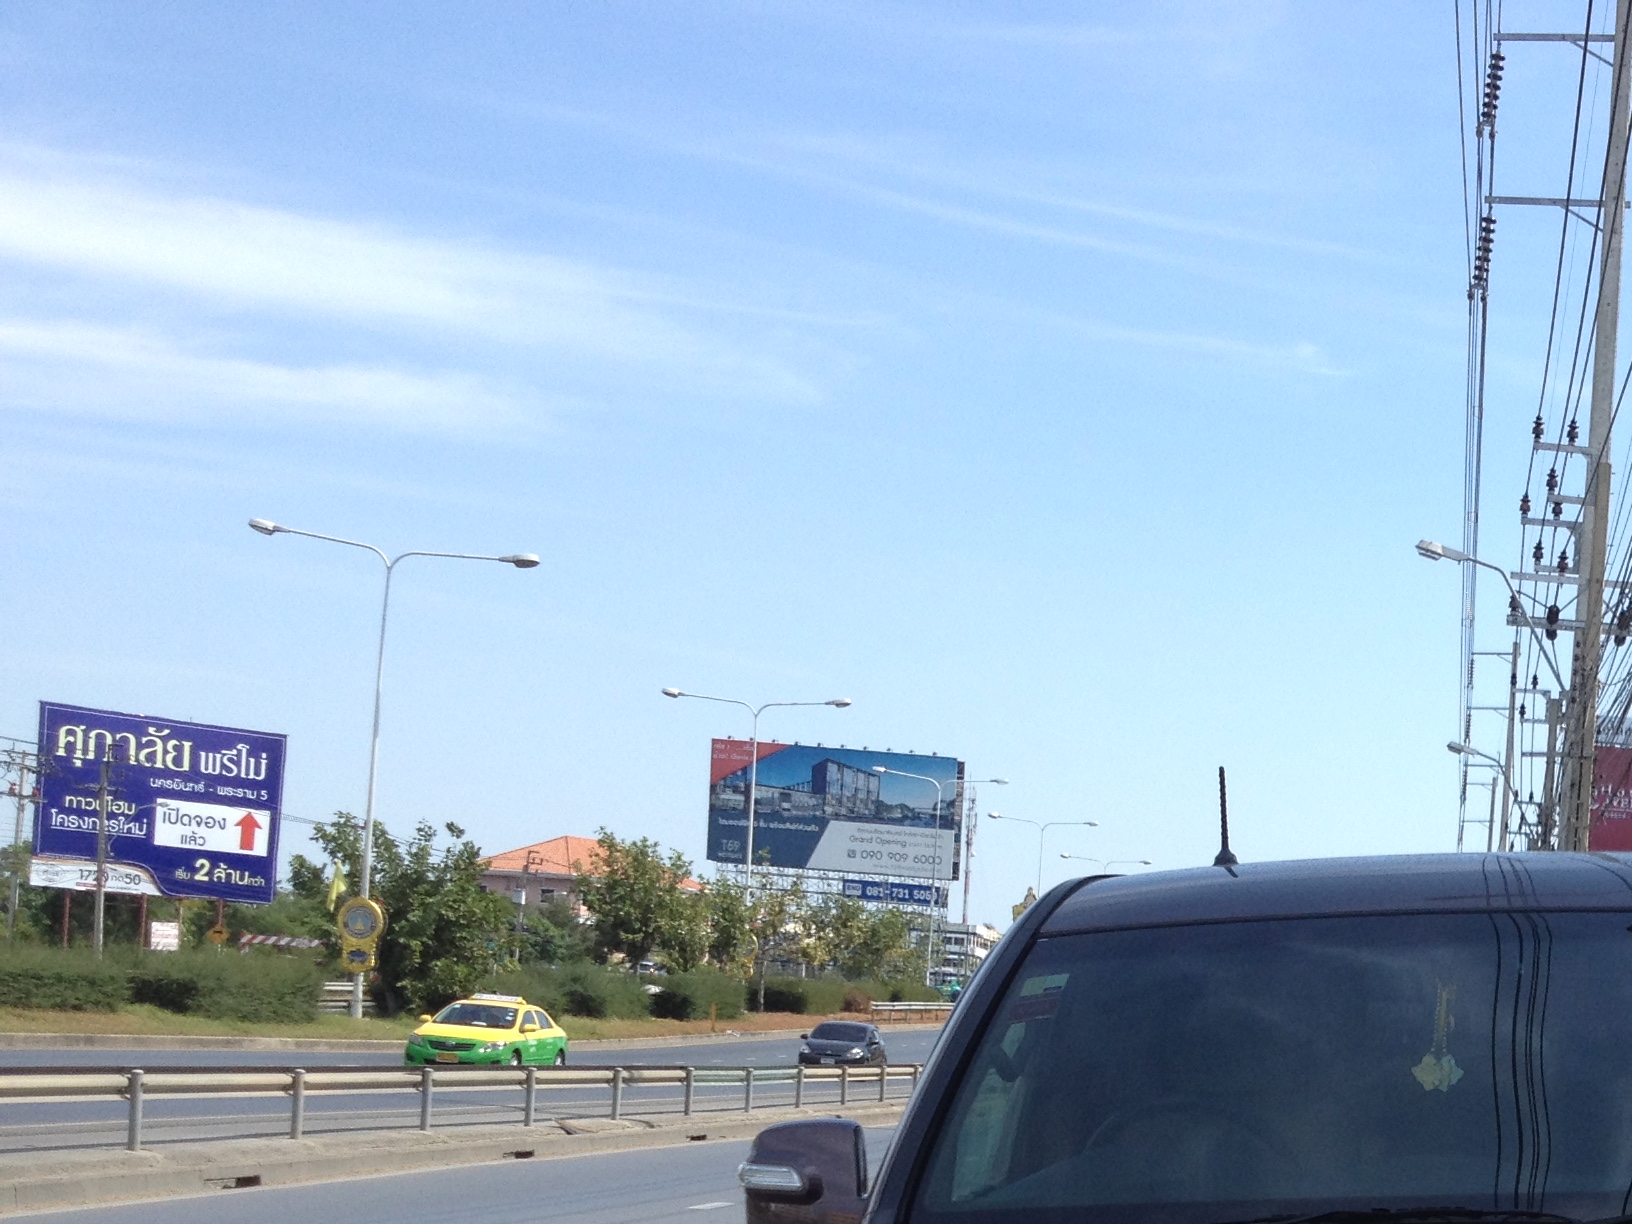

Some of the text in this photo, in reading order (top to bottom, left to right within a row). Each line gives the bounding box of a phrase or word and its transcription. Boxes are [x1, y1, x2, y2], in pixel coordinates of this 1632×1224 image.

[200, 743, 268, 781] พรีโม่
[217, 785, 257, 799] พระราม
[260, 790, 268, 801] 5
[162, 808, 227, 831] เปิดจอง
[180, 831, 206, 847] แล้ว
[849, 834, 906, 849] Grand Opening
[861, 849, 883, 861] 090
[913, 854, 942, 866] 6000
[194, 859, 211, 883] 2
